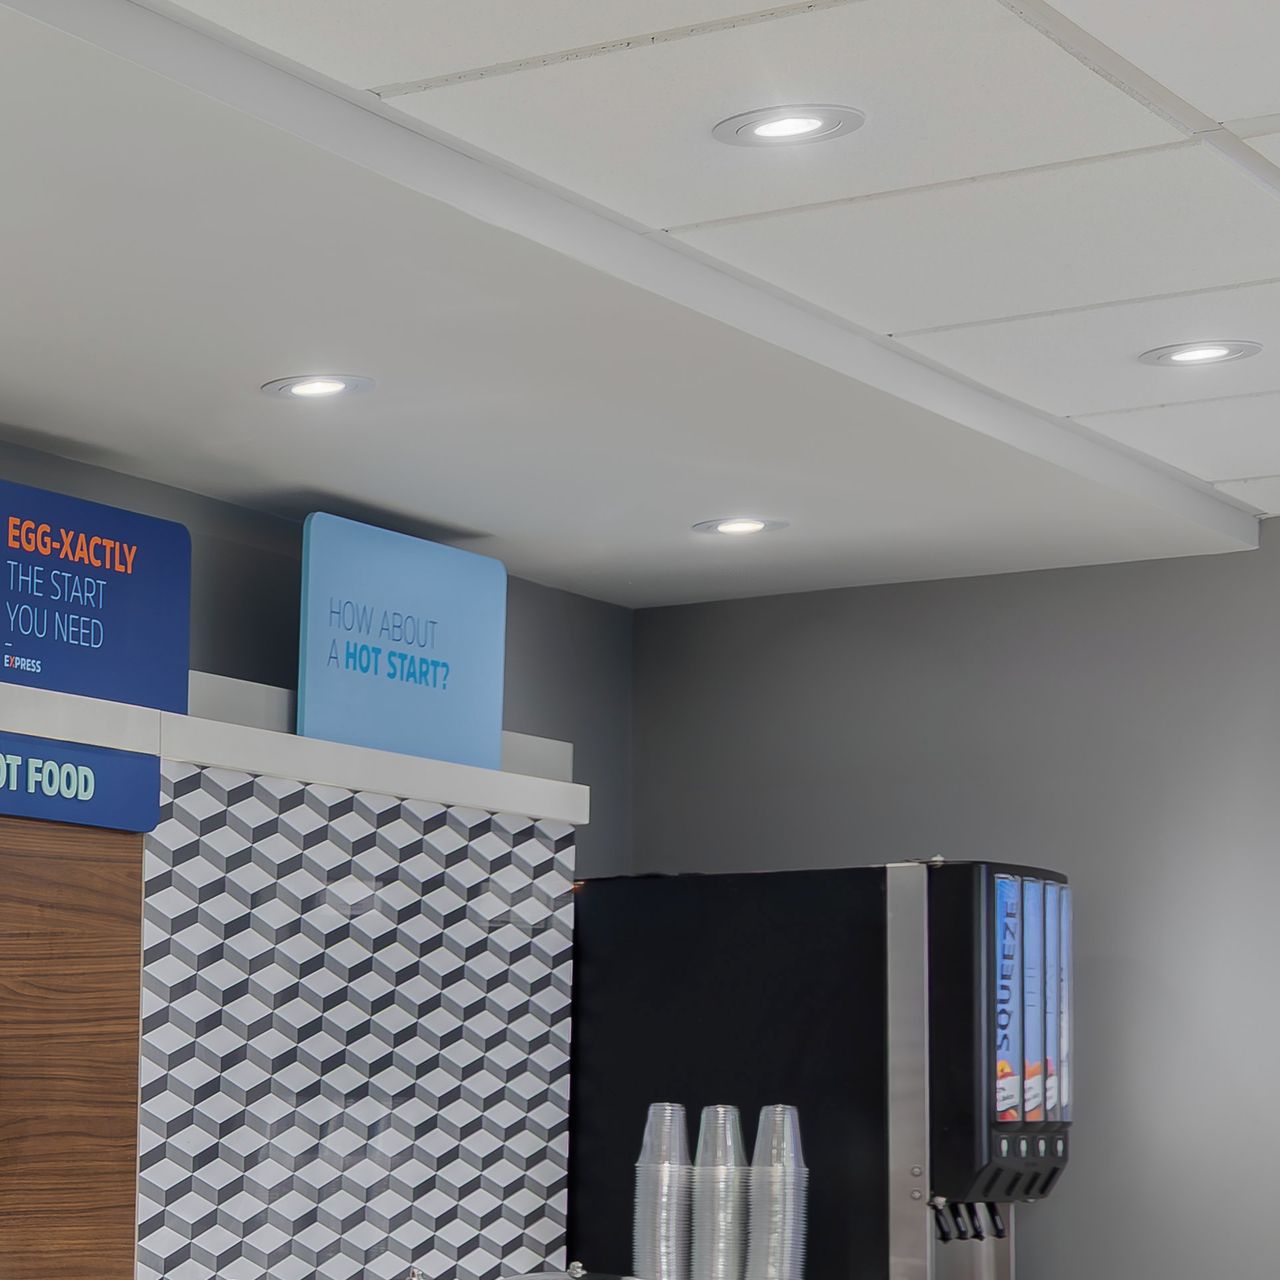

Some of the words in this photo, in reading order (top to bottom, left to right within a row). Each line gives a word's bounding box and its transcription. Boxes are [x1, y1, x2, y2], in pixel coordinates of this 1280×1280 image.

[7, 516, 138, 575] EGG-XACTLY
[6, 560, 45, 598] THE
[49, 570, 108, 610] START
[6, 600, 48, 638] YOU
[54, 611, 104, 649] NEED
[328, 596, 375, 636] HOW
[379, 609, 439, 650] ABOUT
[3, 654, 42, 674] EXPRESS
[327, 638, 340, 669] A
[345, 640, 382, 676] HOT
[386, 650, 450, 691] START?
[27, 757, 96, 801] FOOD
